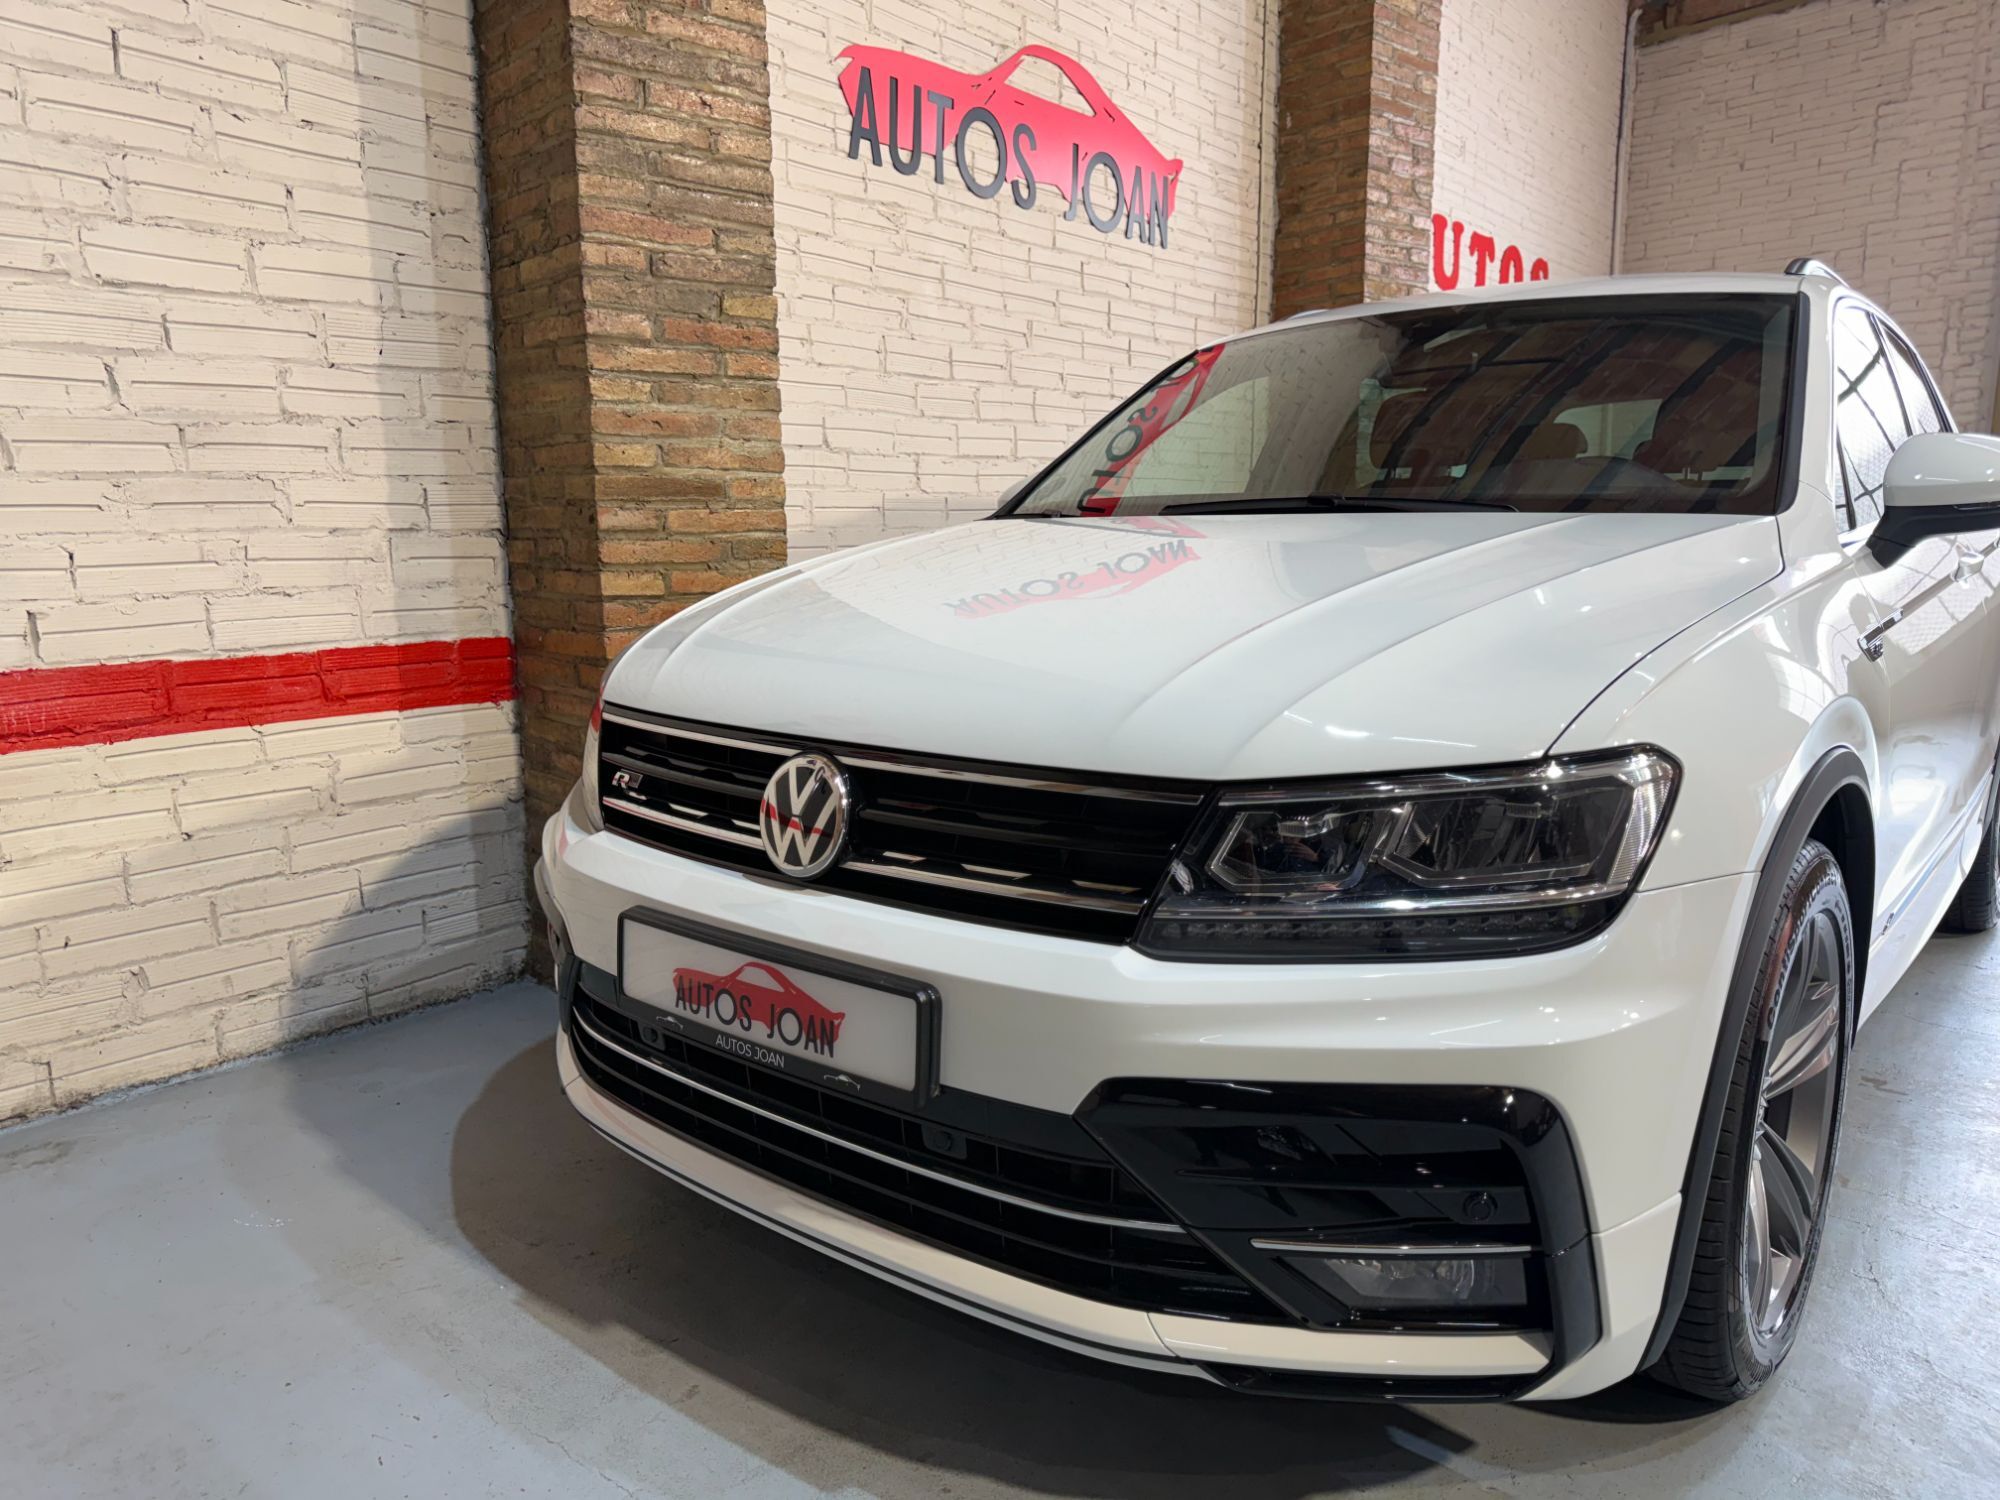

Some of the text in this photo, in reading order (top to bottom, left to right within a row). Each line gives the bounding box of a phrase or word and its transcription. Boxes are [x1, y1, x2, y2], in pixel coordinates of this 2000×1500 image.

[848, 66, 1169, 249] AUTOS JOAN
[675, 975, 834, 1058] AUTOS JOAN
[715, 1033, 785, 1068] AUTOS JOAN
